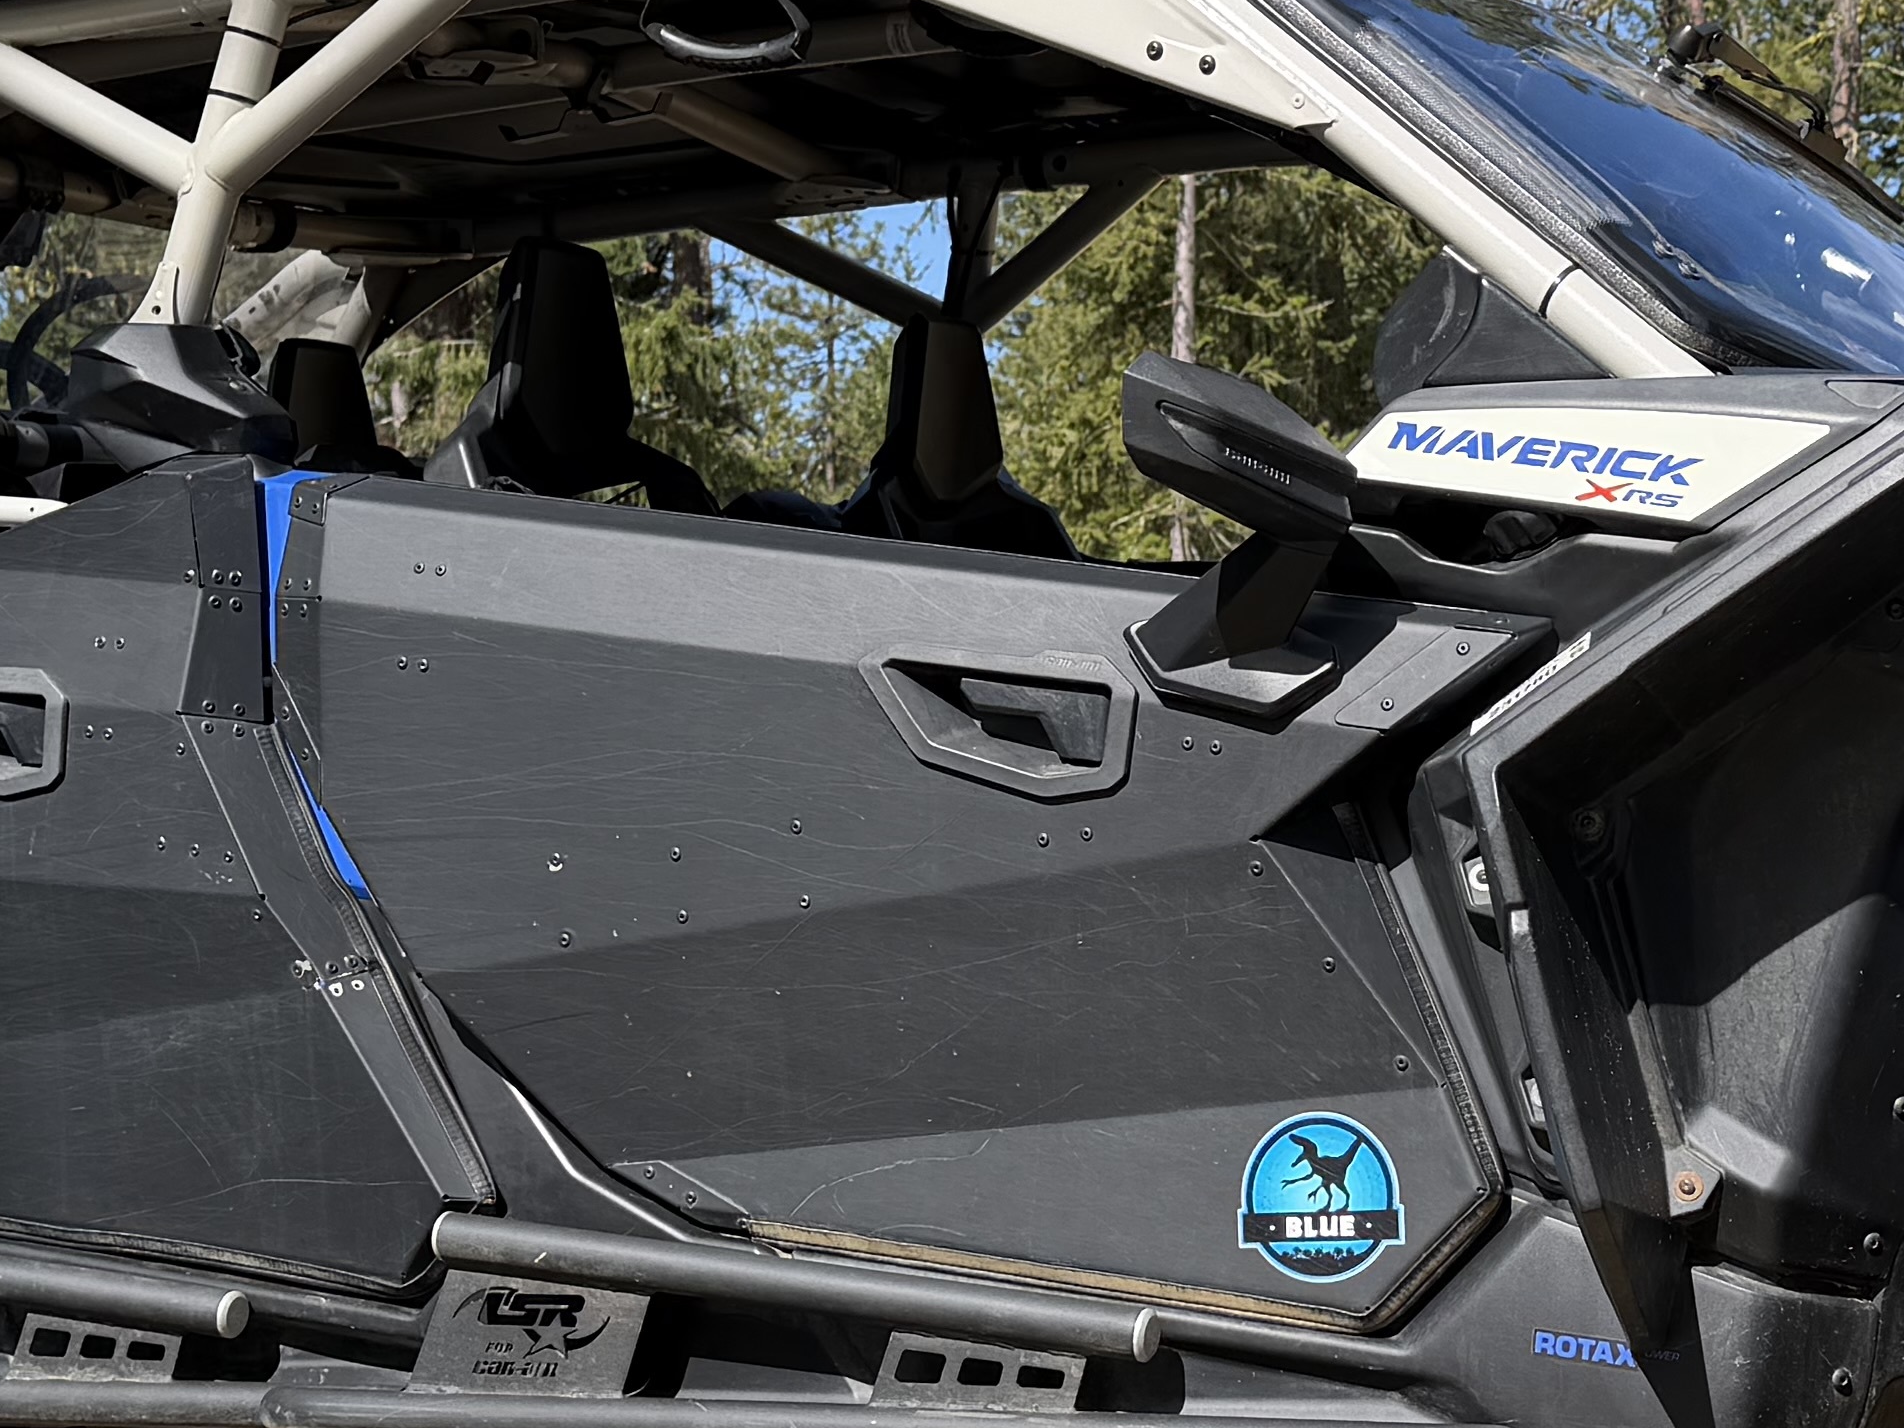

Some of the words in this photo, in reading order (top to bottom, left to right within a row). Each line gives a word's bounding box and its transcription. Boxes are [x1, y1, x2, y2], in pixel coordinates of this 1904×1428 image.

[1388, 421, 1705, 487] MAVERICK
[1285, 1215, 1356, 1239] BLUE
[485, 1342, 514, 1354] FOR
[1534, 1331, 1636, 1367] ROTAX
[473, 1360, 559, 1378] can-am
